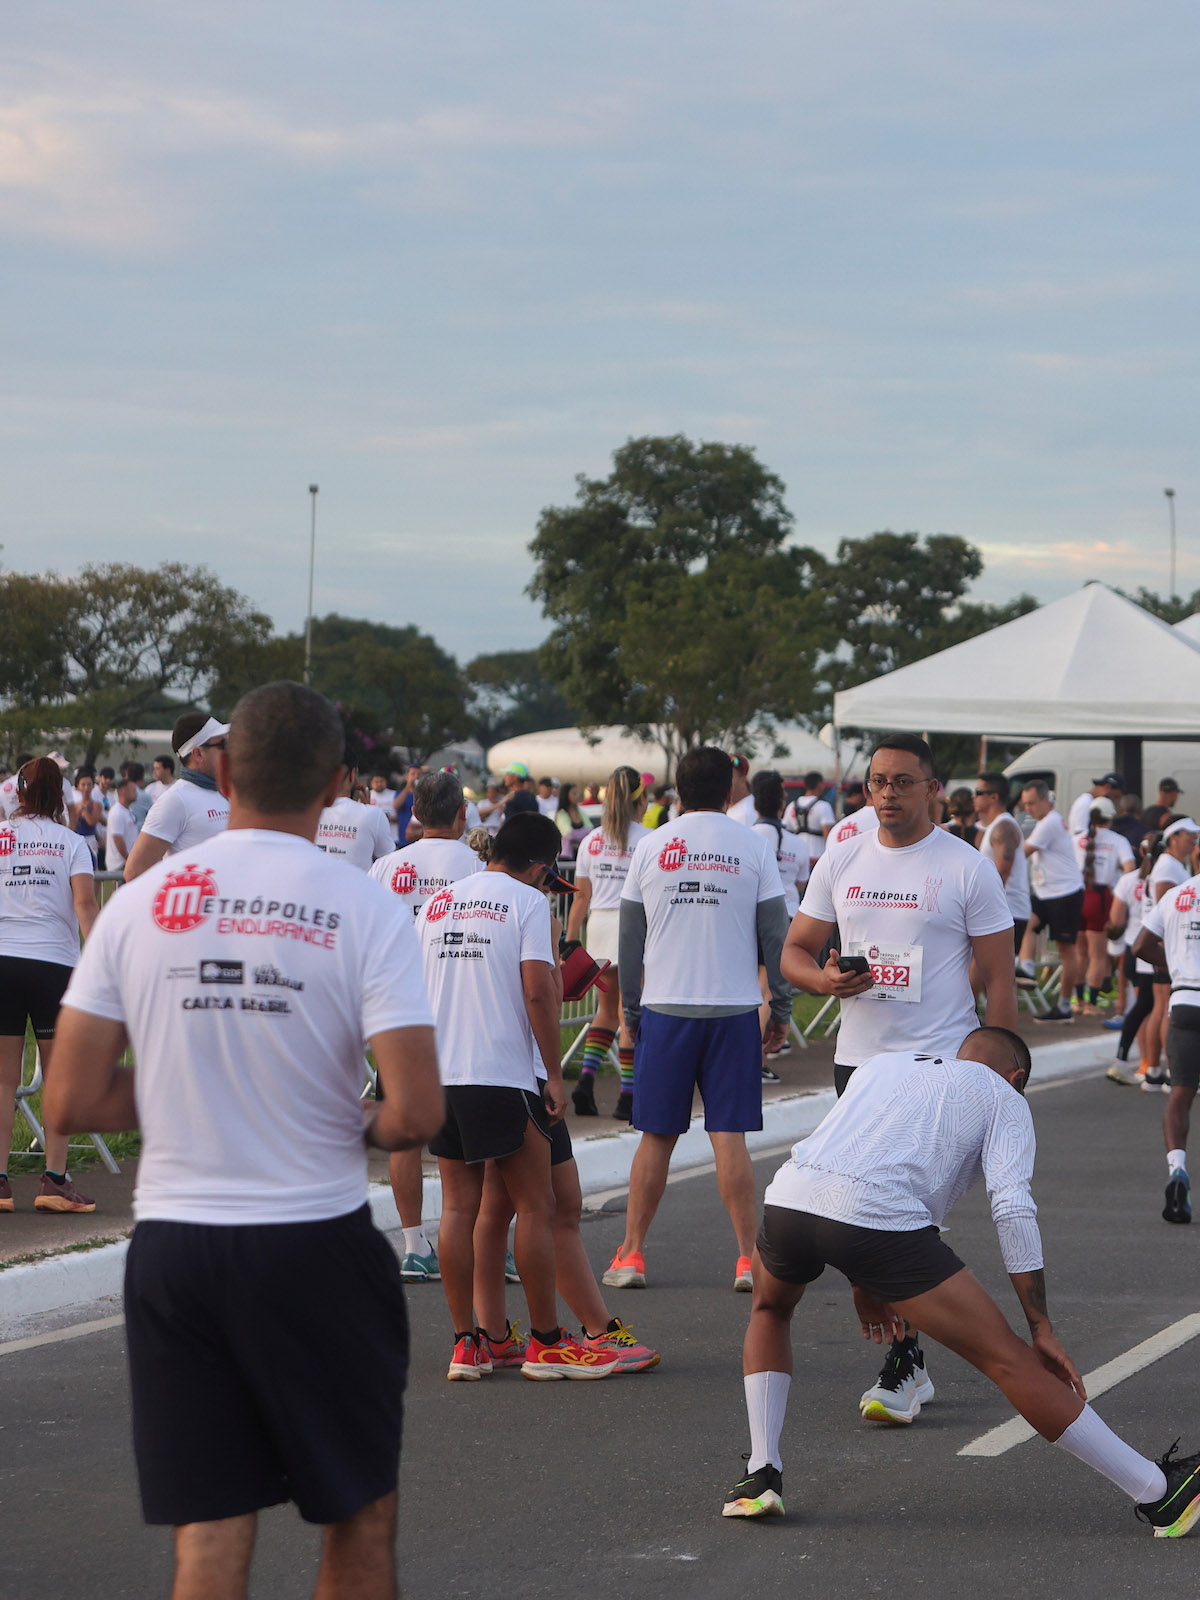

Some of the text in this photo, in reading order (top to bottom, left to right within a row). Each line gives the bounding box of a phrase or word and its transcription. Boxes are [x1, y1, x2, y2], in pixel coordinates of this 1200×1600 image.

[664, 848, 741, 866] METRÓPOLES
[687, 862, 741, 875] ENDURANCE
[670, 897, 694, 905] CAIXA
[846, 885, 918, 902] METRÓPOLES
[163, 884, 342, 930] METRÓPOLES
[430, 898, 510, 916] METRÓPOLES
[452, 908, 508, 923] ENDURANCE
[216, 916, 338, 951] ENDURANCE
[869, 965, 908, 986] 332
[182, 995, 235, 1011] CAIXA
